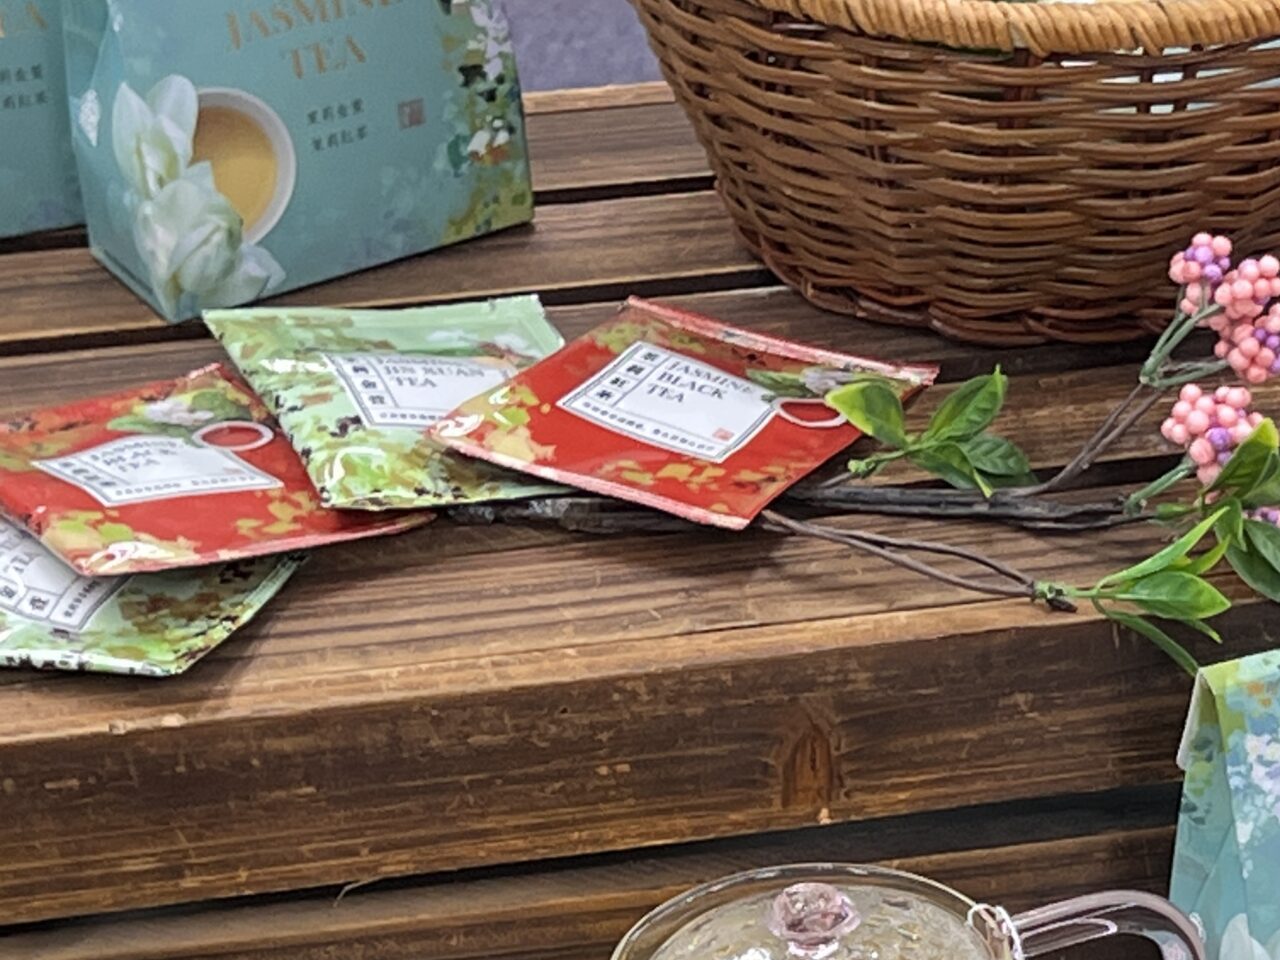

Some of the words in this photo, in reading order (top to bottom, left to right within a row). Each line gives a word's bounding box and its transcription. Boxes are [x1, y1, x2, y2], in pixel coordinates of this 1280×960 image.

[281, 34, 367, 80] TEA
[647, 382, 685, 404] TEA
[657, 371, 728, 401] BLACK
[665, 360, 756, 394] JASMINE
